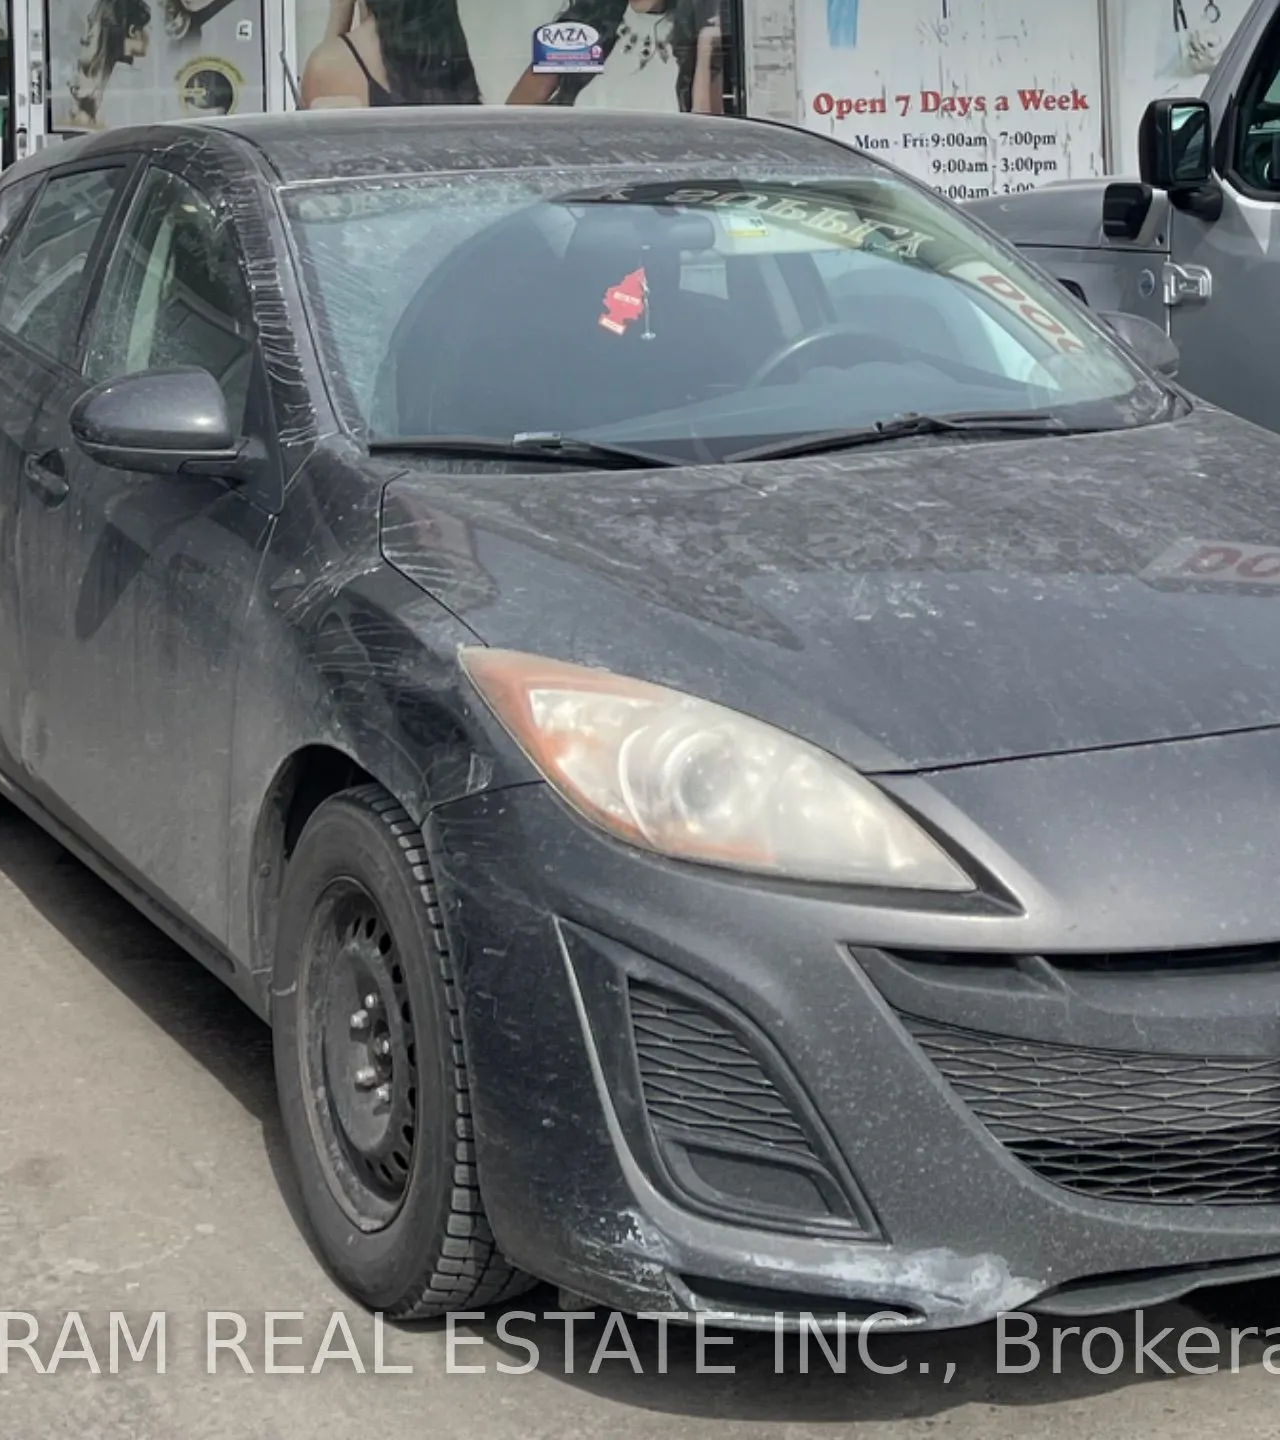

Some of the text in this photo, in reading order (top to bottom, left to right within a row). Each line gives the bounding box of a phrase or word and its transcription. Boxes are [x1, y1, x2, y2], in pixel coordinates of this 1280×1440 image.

[542, 28, 588, 43] RAZA
[812, 89, 1089, 120] Open 7 Days a Week
[855, 132, 1057, 149] Mon Fri: 9:00am 7:00pm
[932, 158, 1057, 174] 9:00am 3:00pm
